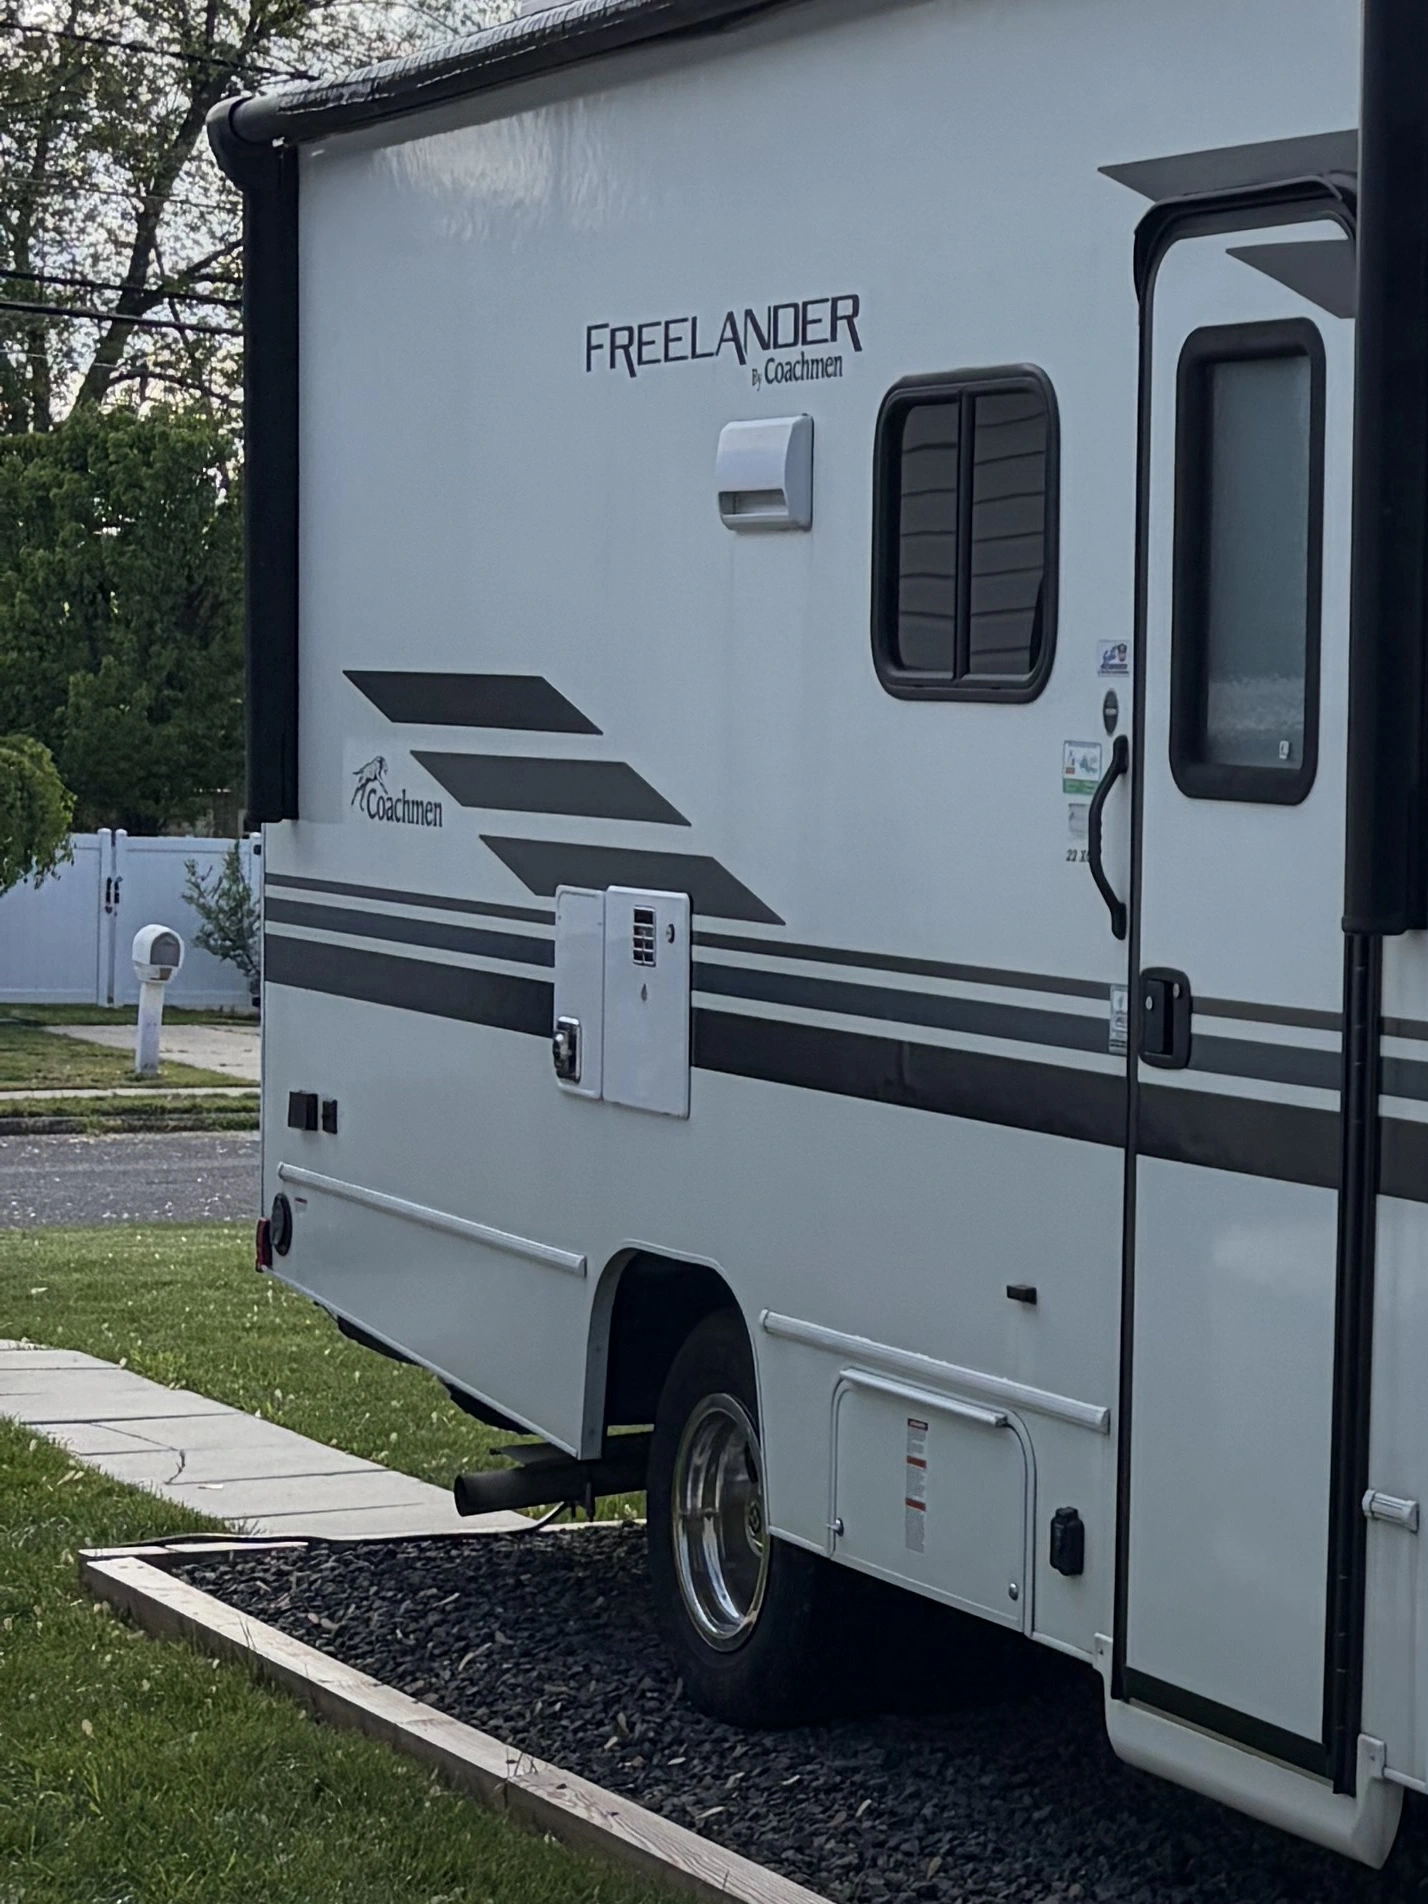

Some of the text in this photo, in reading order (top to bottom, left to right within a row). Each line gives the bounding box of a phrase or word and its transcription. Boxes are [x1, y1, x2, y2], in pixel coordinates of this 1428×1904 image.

[586, 294, 863, 378] FREELANDER
[764, 351, 843, 385] Coachmen
[366, 788, 443, 828] Coachmen
